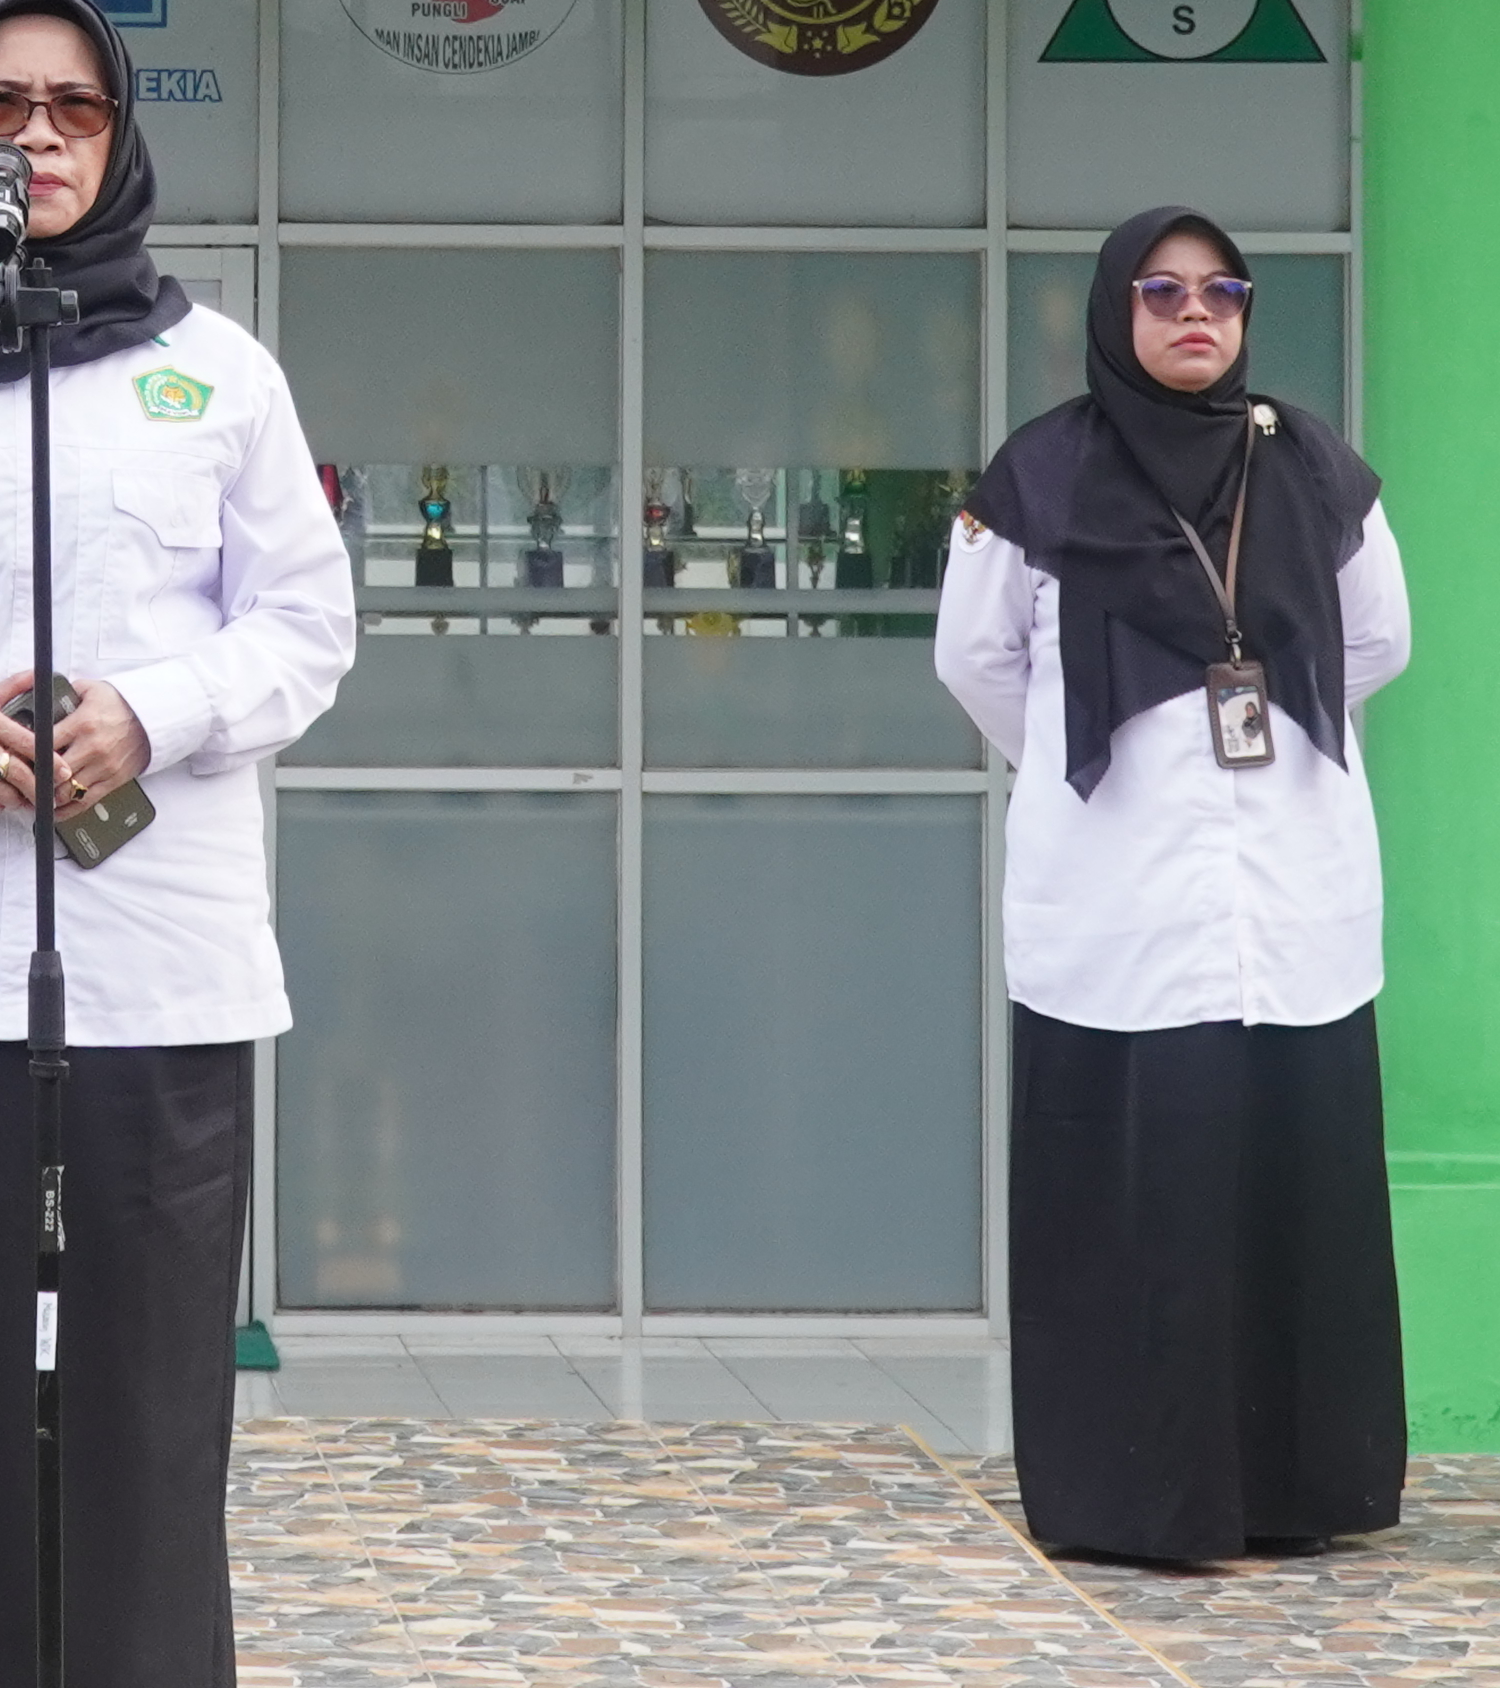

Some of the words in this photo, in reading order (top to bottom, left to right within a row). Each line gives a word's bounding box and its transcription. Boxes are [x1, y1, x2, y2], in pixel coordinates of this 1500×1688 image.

[411, 2, 468, 19] PUNGLI
[375, 28, 400, 52] MAN
[403, 32, 440, 69] INSAN
[442, 31, 503, 70] CENDEKIA
[505, 29, 540, 60] JAMBI
[135, 69, 222, 102] EKIA
[44, 1190, 55, 1232] BS-222
